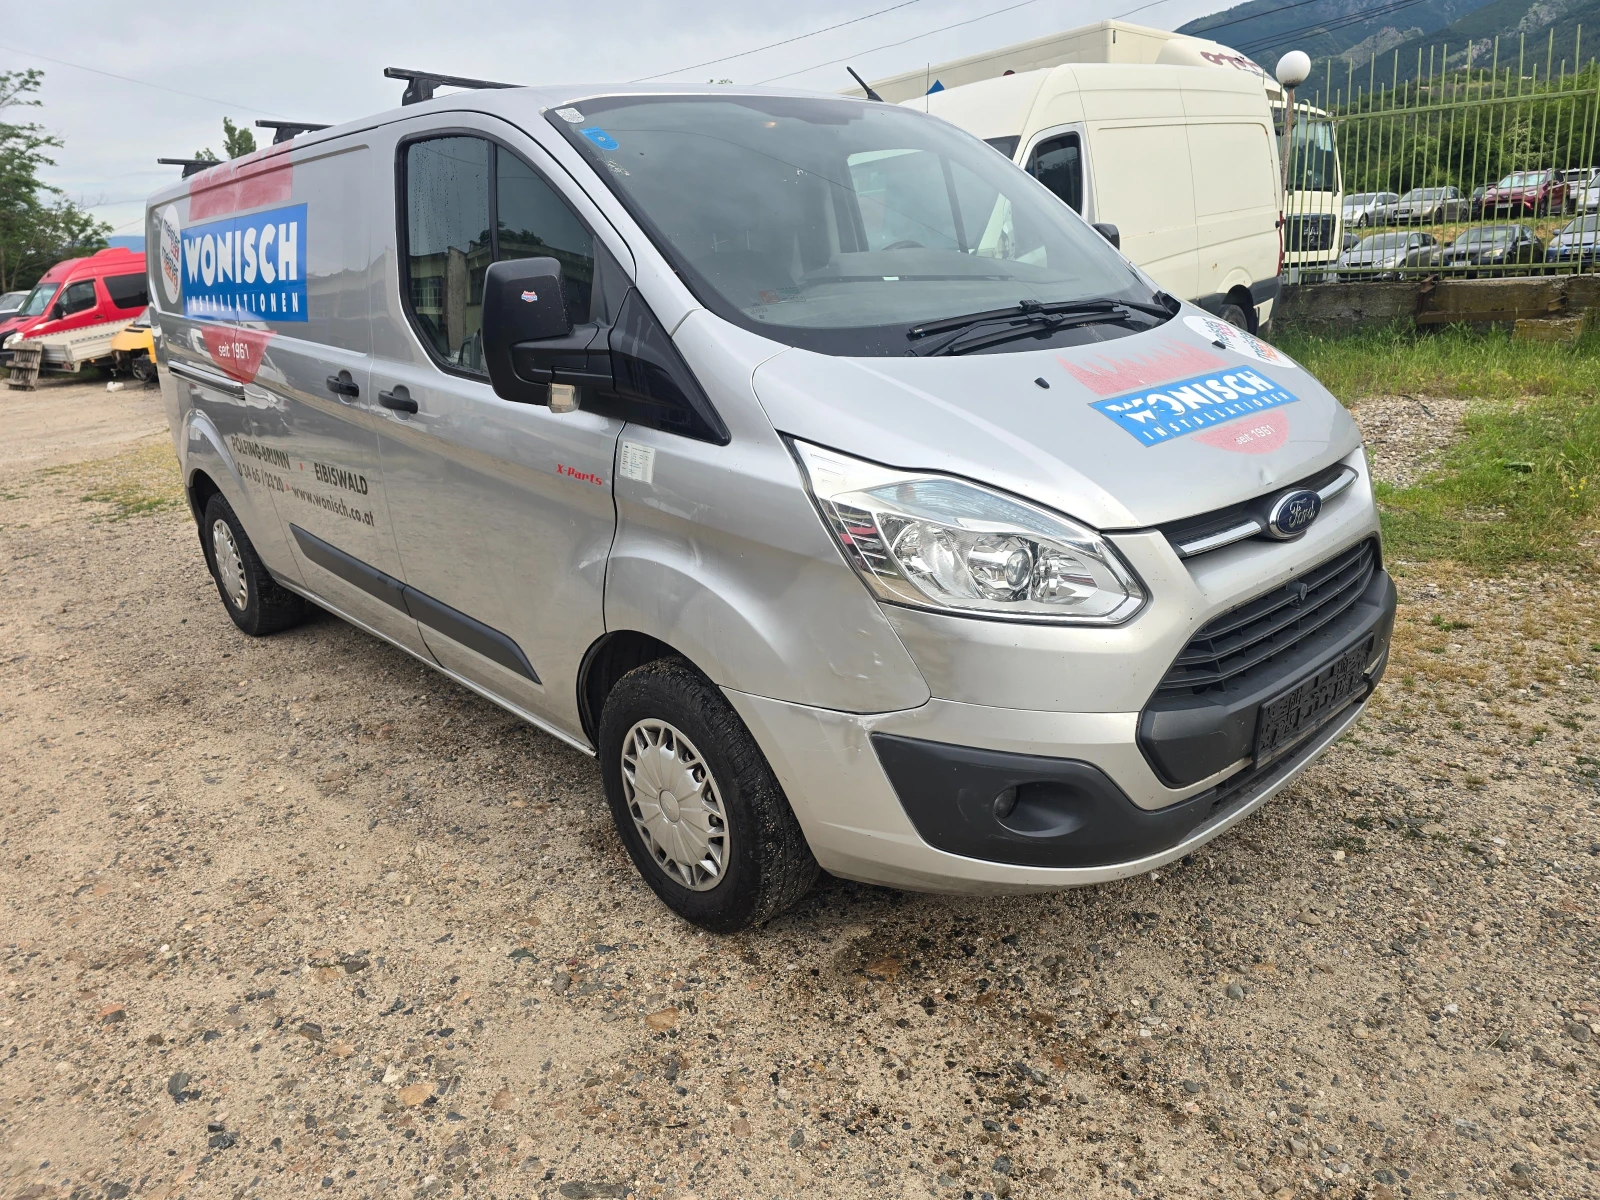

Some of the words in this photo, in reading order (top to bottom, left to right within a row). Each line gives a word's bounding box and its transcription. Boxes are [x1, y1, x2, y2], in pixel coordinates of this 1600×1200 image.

[183, 221, 298, 287] WONISCH
[186, 292, 299, 313] INSTALLATIONEN
[218, 341, 230, 358] seit
[231, 342, 250, 360] 1961
[1105, 370, 1275, 424] WONISCH
[1142, 391, 1290, 440] INSTALLATIONEN
[1235, 433, 1252, 446] seit
[1251, 425, 1276, 439] 1961
[231, 432, 291, 471] PÖLFING-BRUNN
[314, 462, 369, 496] EIBISWALD
[556, 463, 603, 486] X-Parts
[291, 486, 375, 527] www.wonisch.co.at
[1289, 497, 1316, 528] Ford
